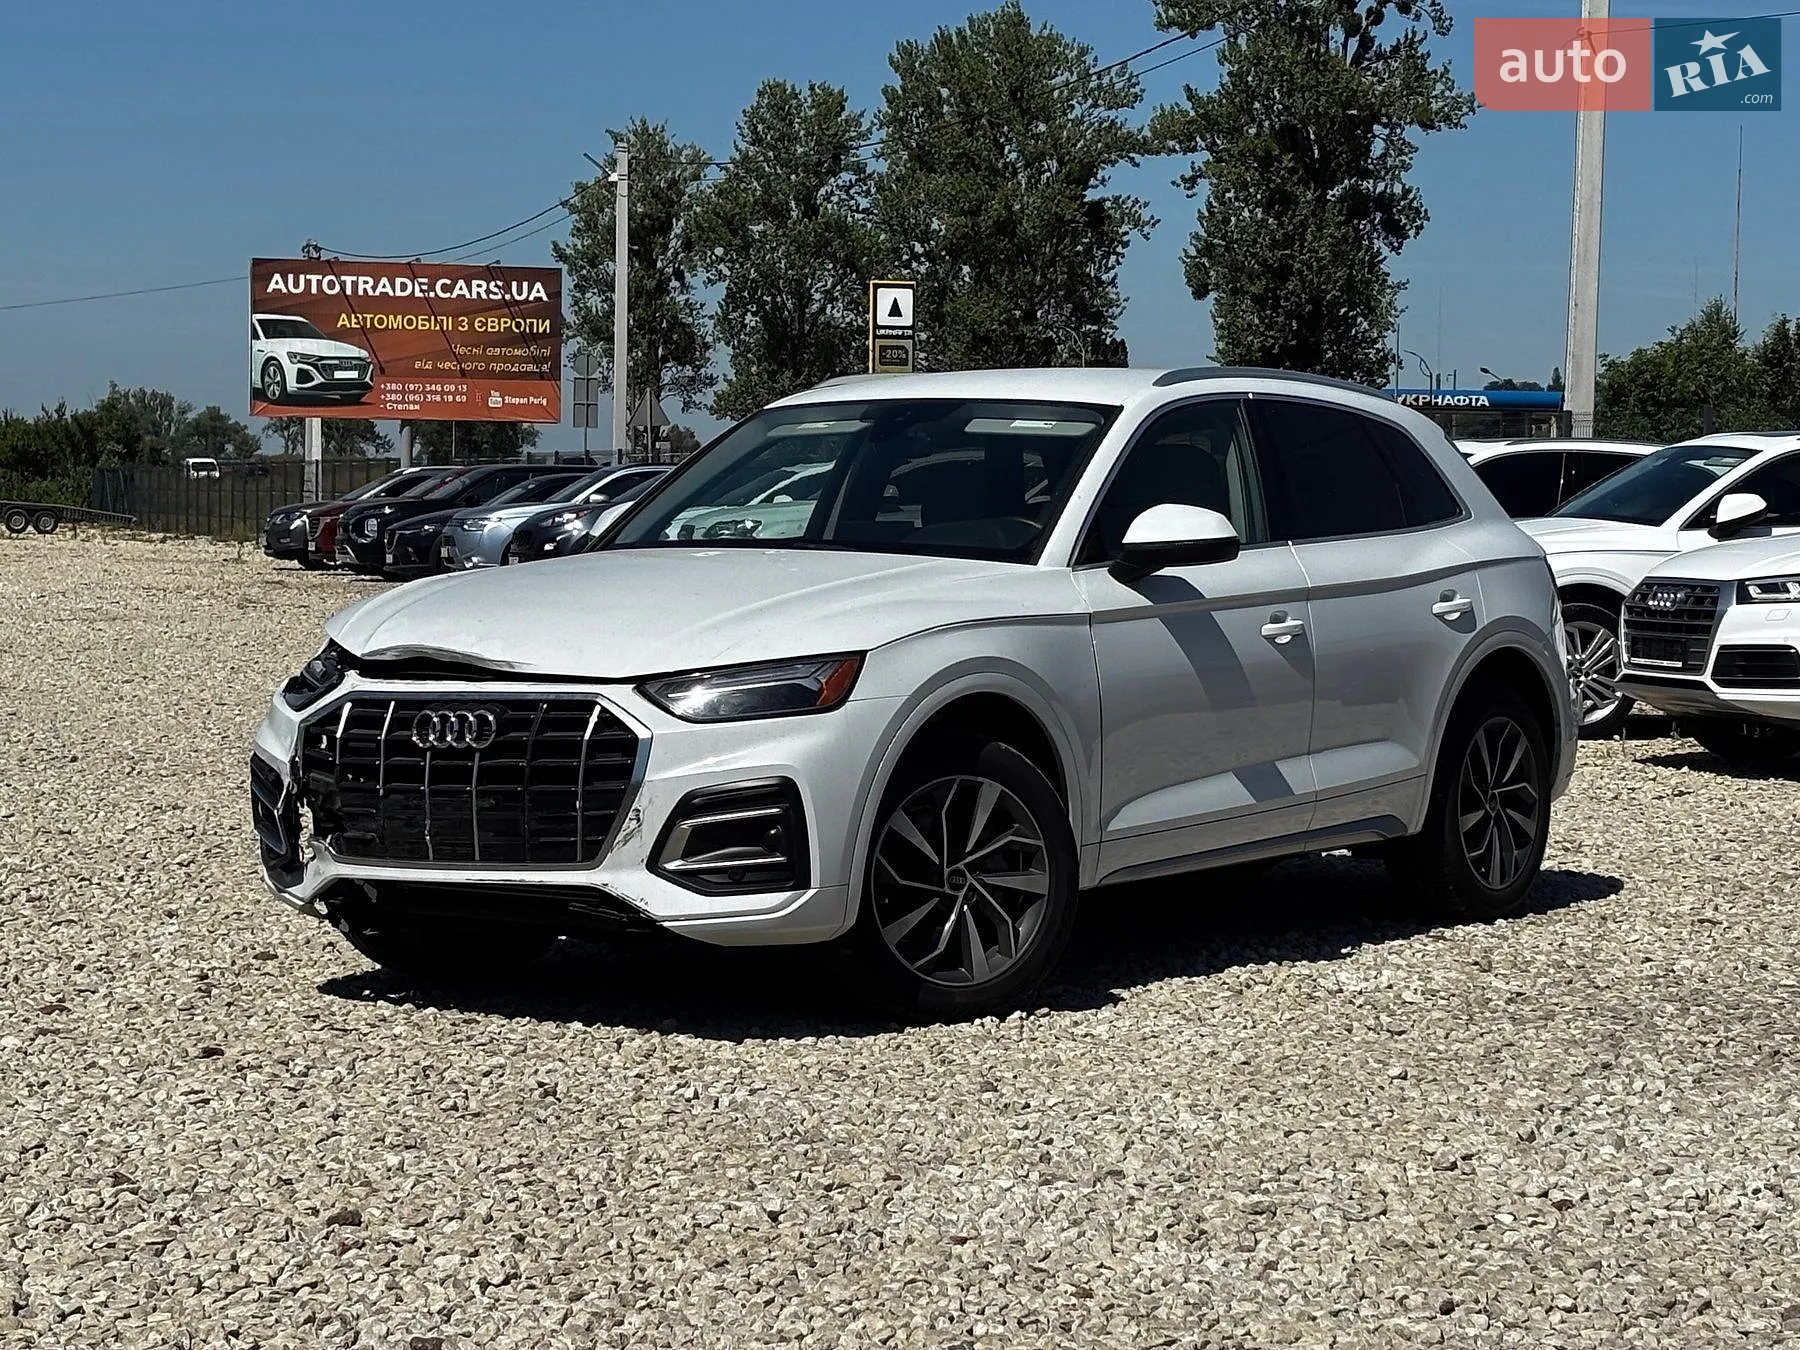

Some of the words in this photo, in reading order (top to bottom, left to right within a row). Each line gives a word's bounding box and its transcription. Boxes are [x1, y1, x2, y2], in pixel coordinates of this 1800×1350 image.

[266, 273, 549, 302] AUTOTRADE.CARS.UA
[337, 312, 453, 332] АВТОМОБІЛІ
[474, 317, 551, 335] ЄВРОПИ
[386, 402, 421, 411] Степан
